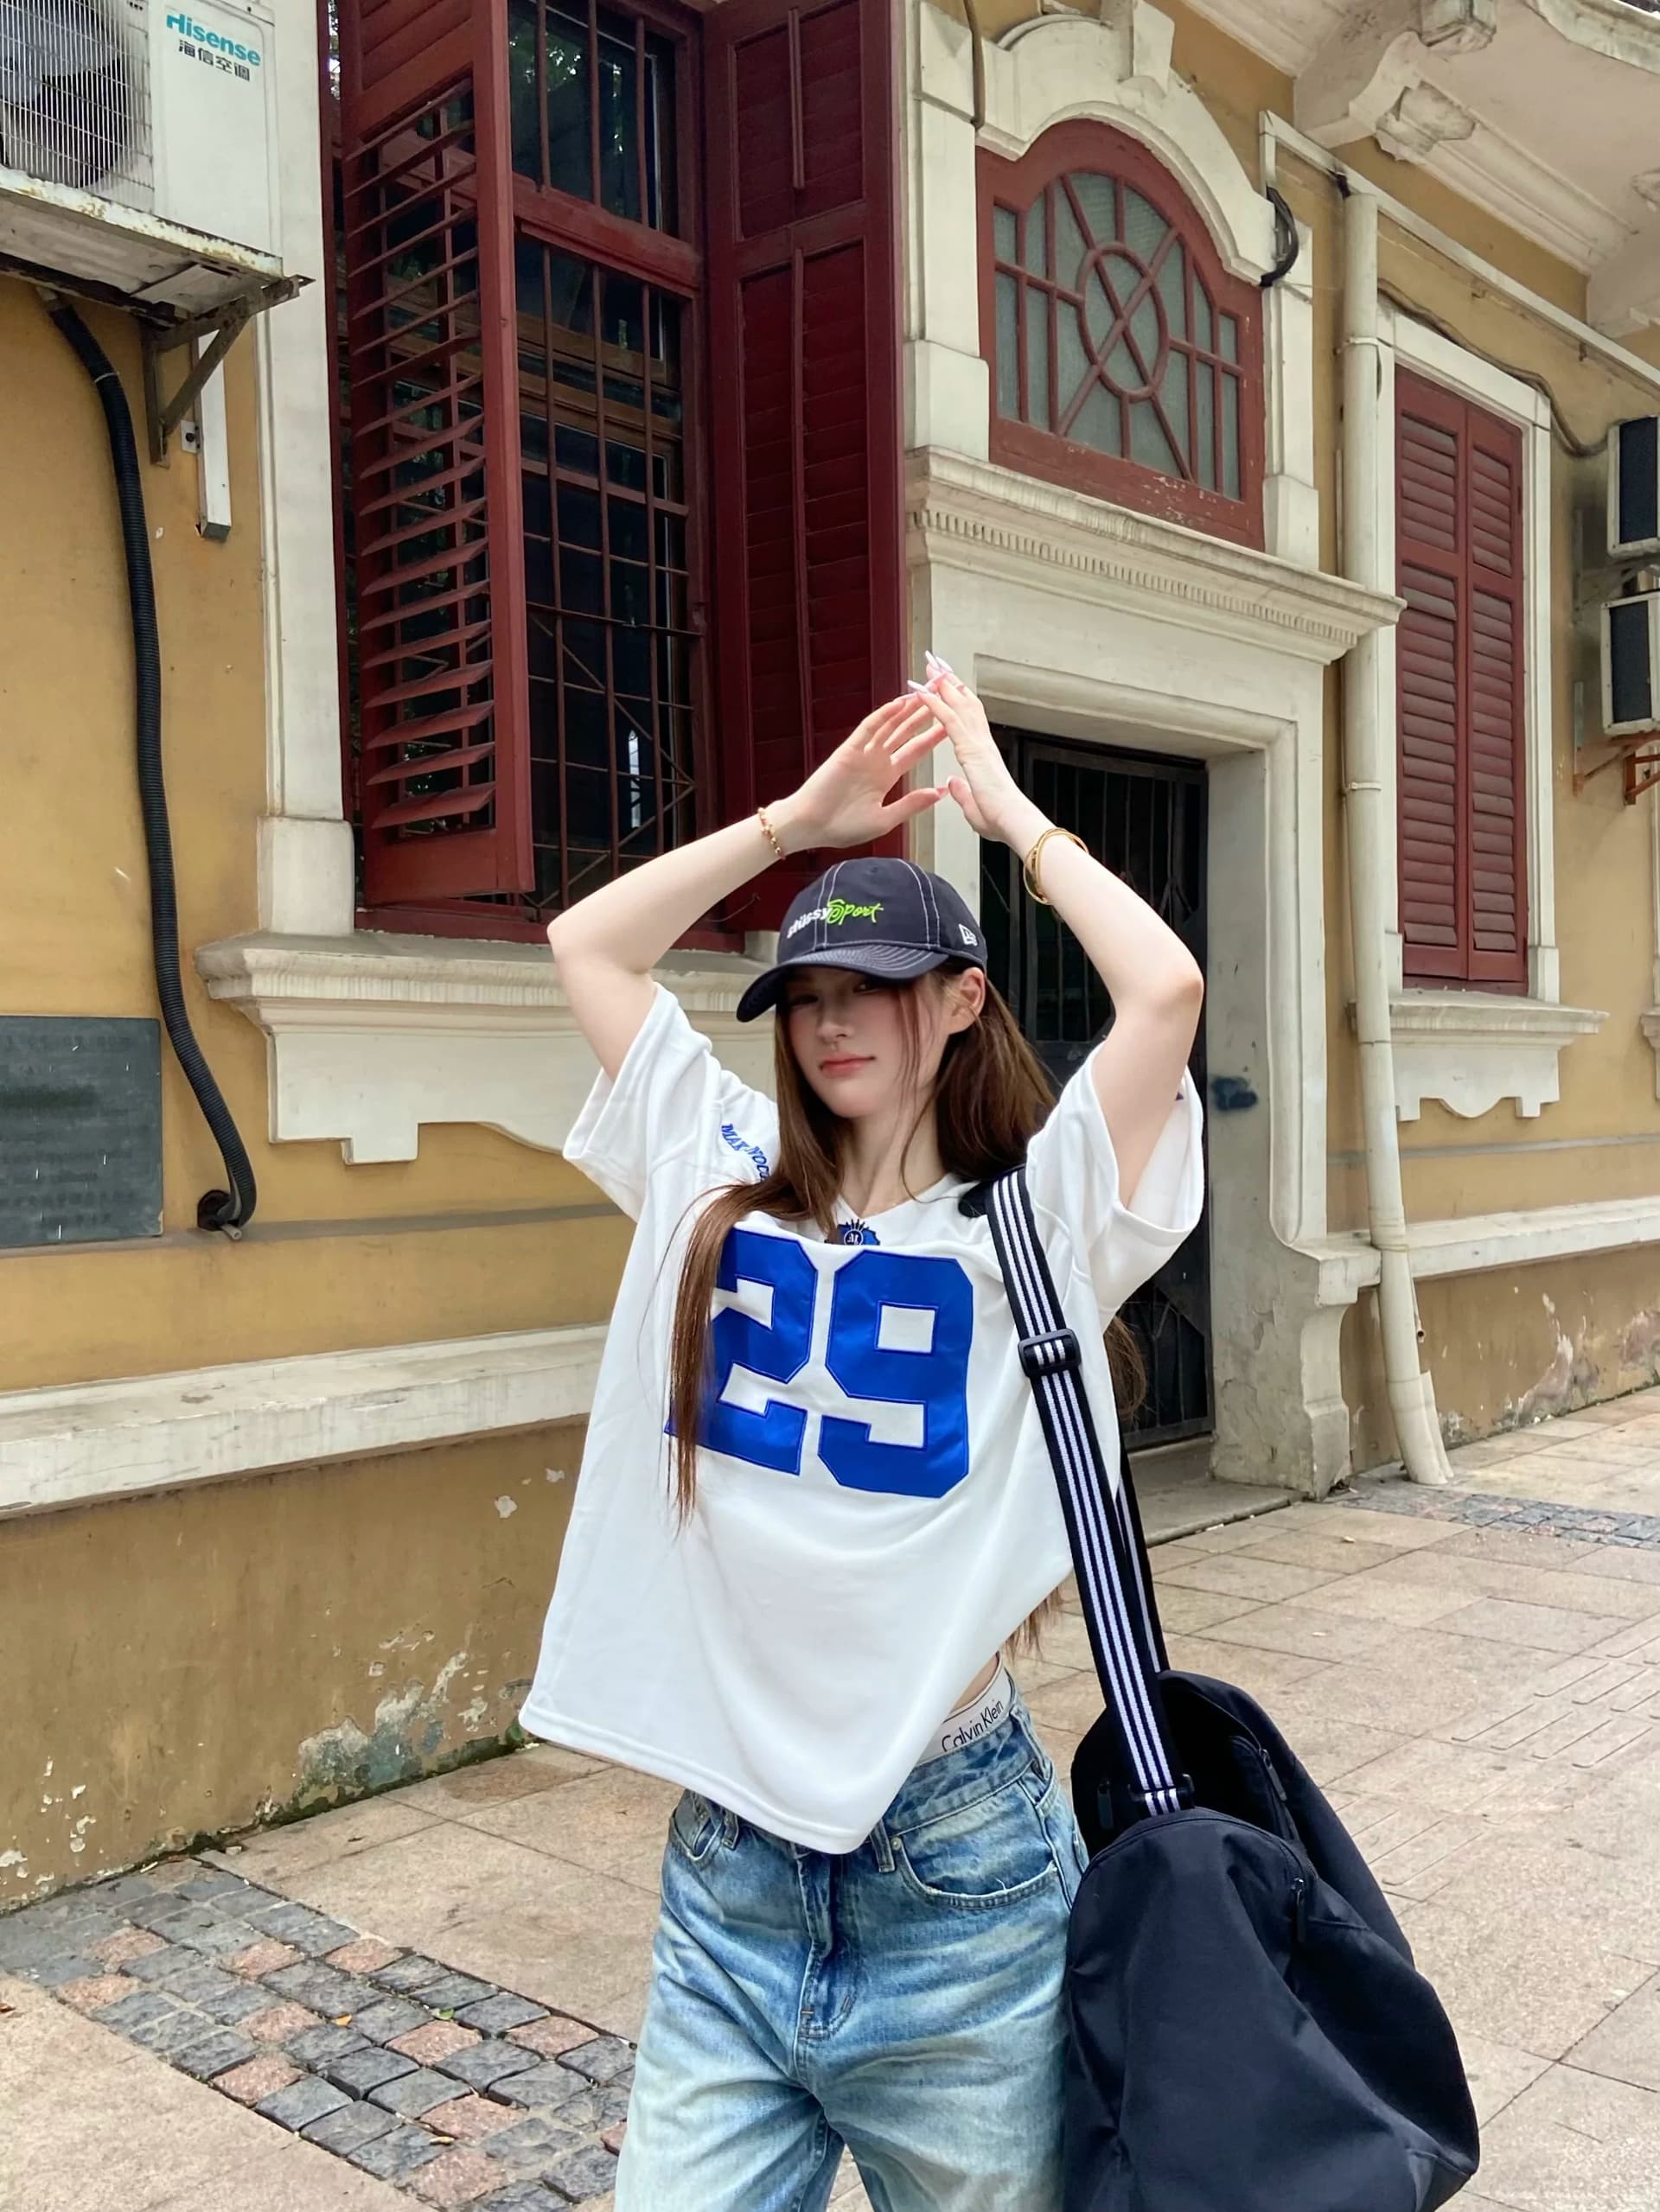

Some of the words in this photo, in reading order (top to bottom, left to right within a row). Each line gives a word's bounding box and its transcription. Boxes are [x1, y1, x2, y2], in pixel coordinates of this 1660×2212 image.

[166, 13, 261, 67] Hisense
[665, 1227, 974, 1499] 29
[942, 1720, 984, 1752] Calvin
[980, 1698, 1005, 1729] Klein
